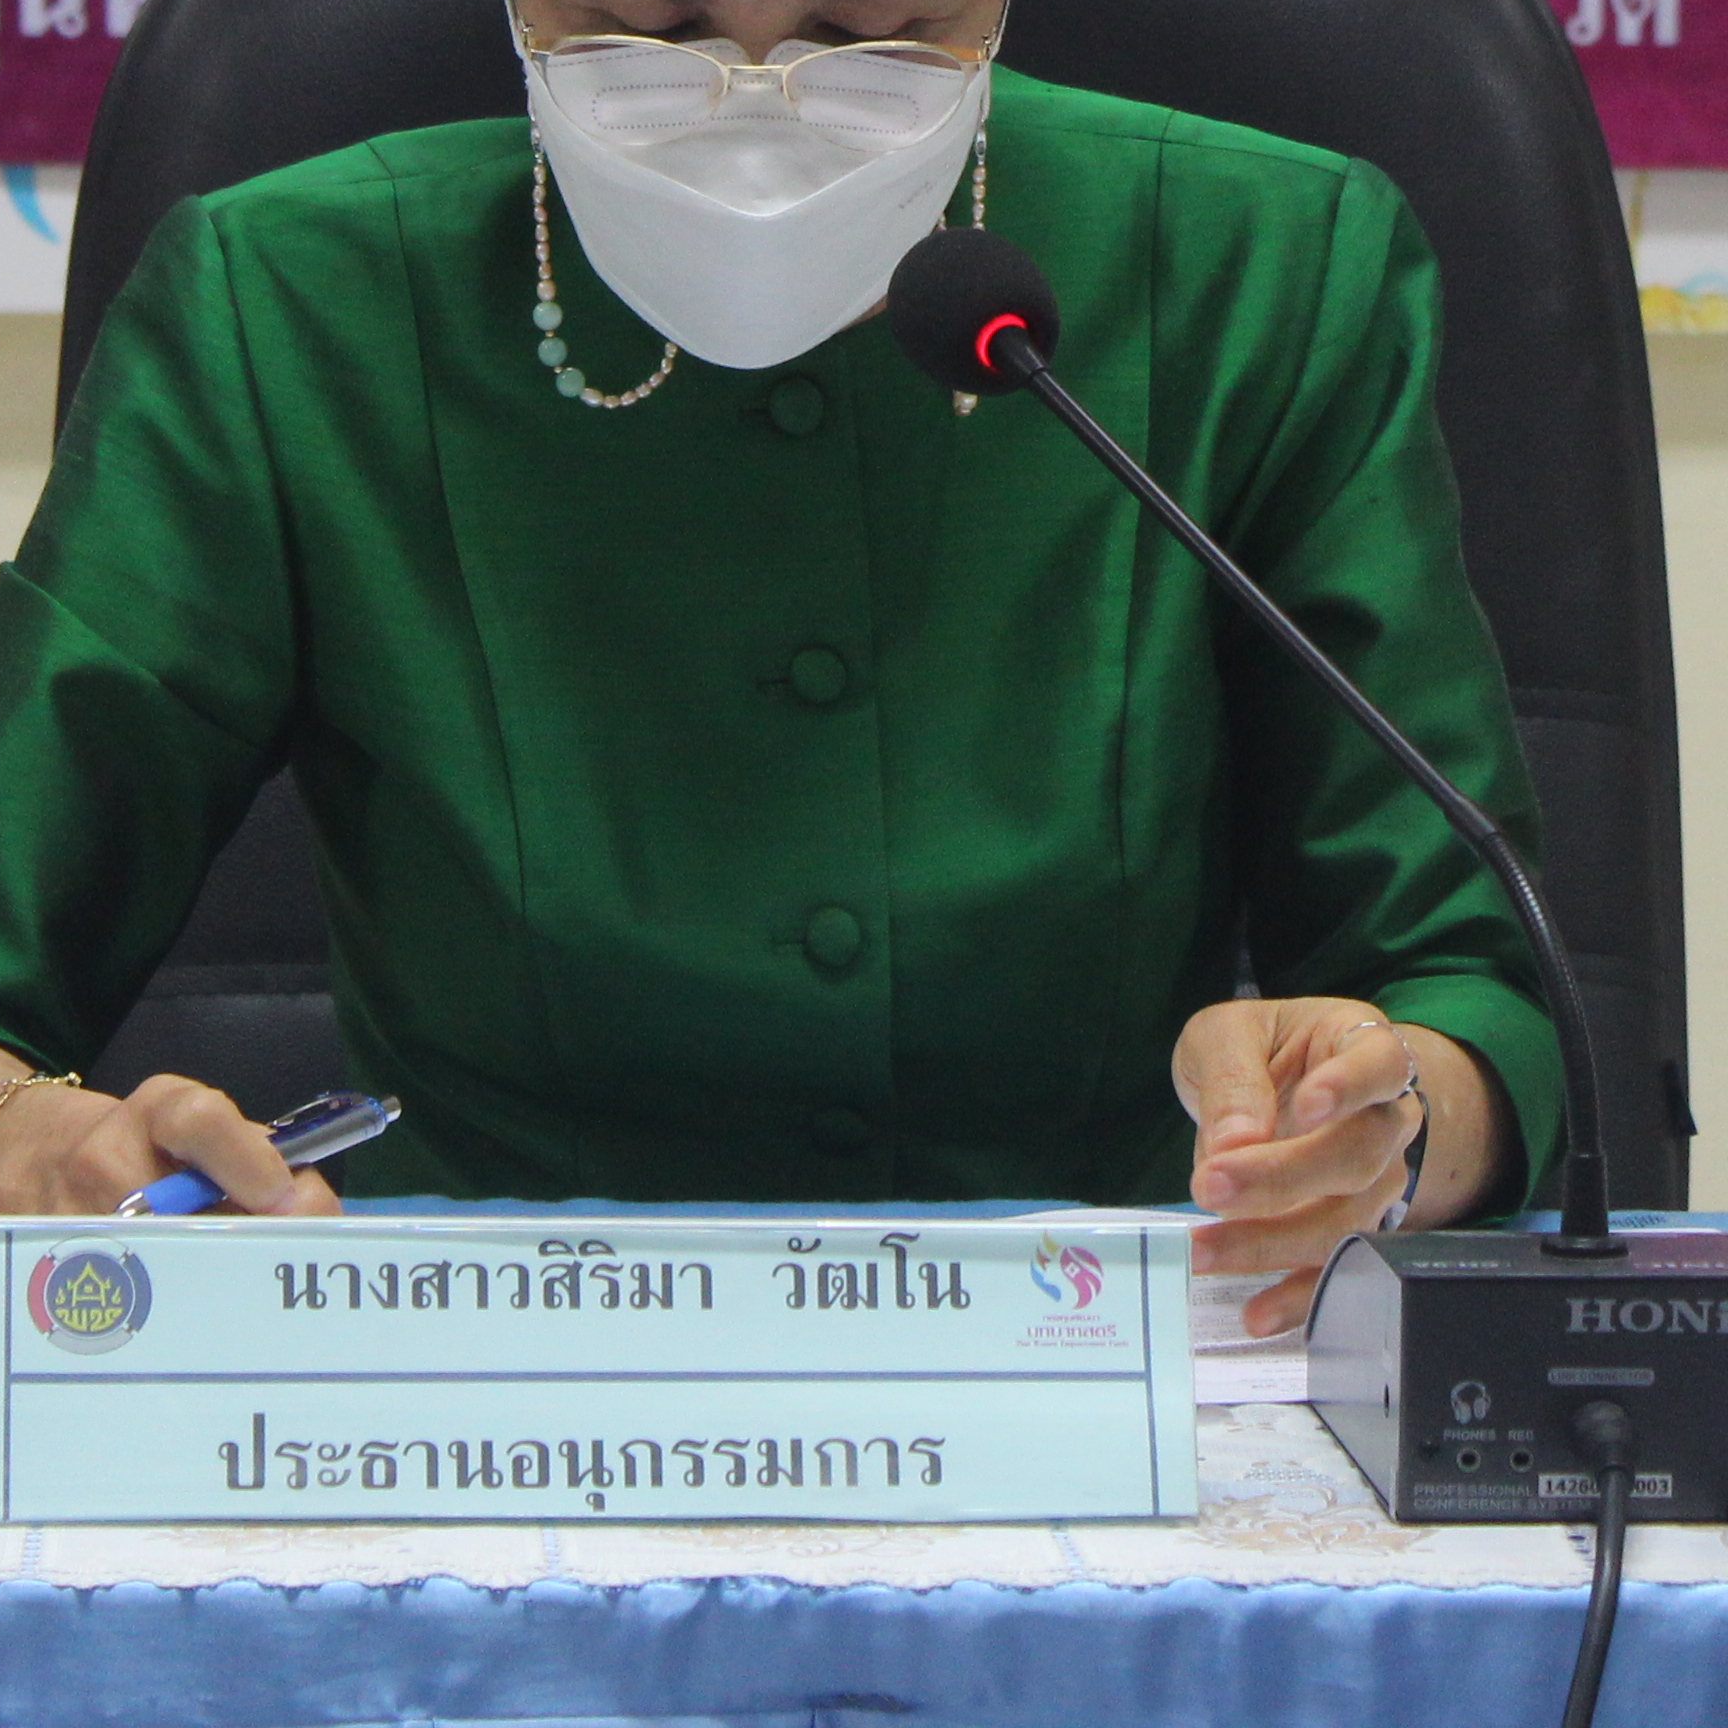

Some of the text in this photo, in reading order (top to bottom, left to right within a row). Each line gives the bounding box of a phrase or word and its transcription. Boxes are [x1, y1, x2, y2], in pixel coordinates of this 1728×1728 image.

[275, 1232, 973, 1312] นางสาวสิริมา วัฒโน
[1442, 1429, 1496, 1442] PHONES
[217, 1412, 948, 1513] ประธานอนุกรรมการ
[1413, 1483, 1533, 1497] PROFESSIONAL
[1413, 1498, 1521, 1511] CONFERENCE
